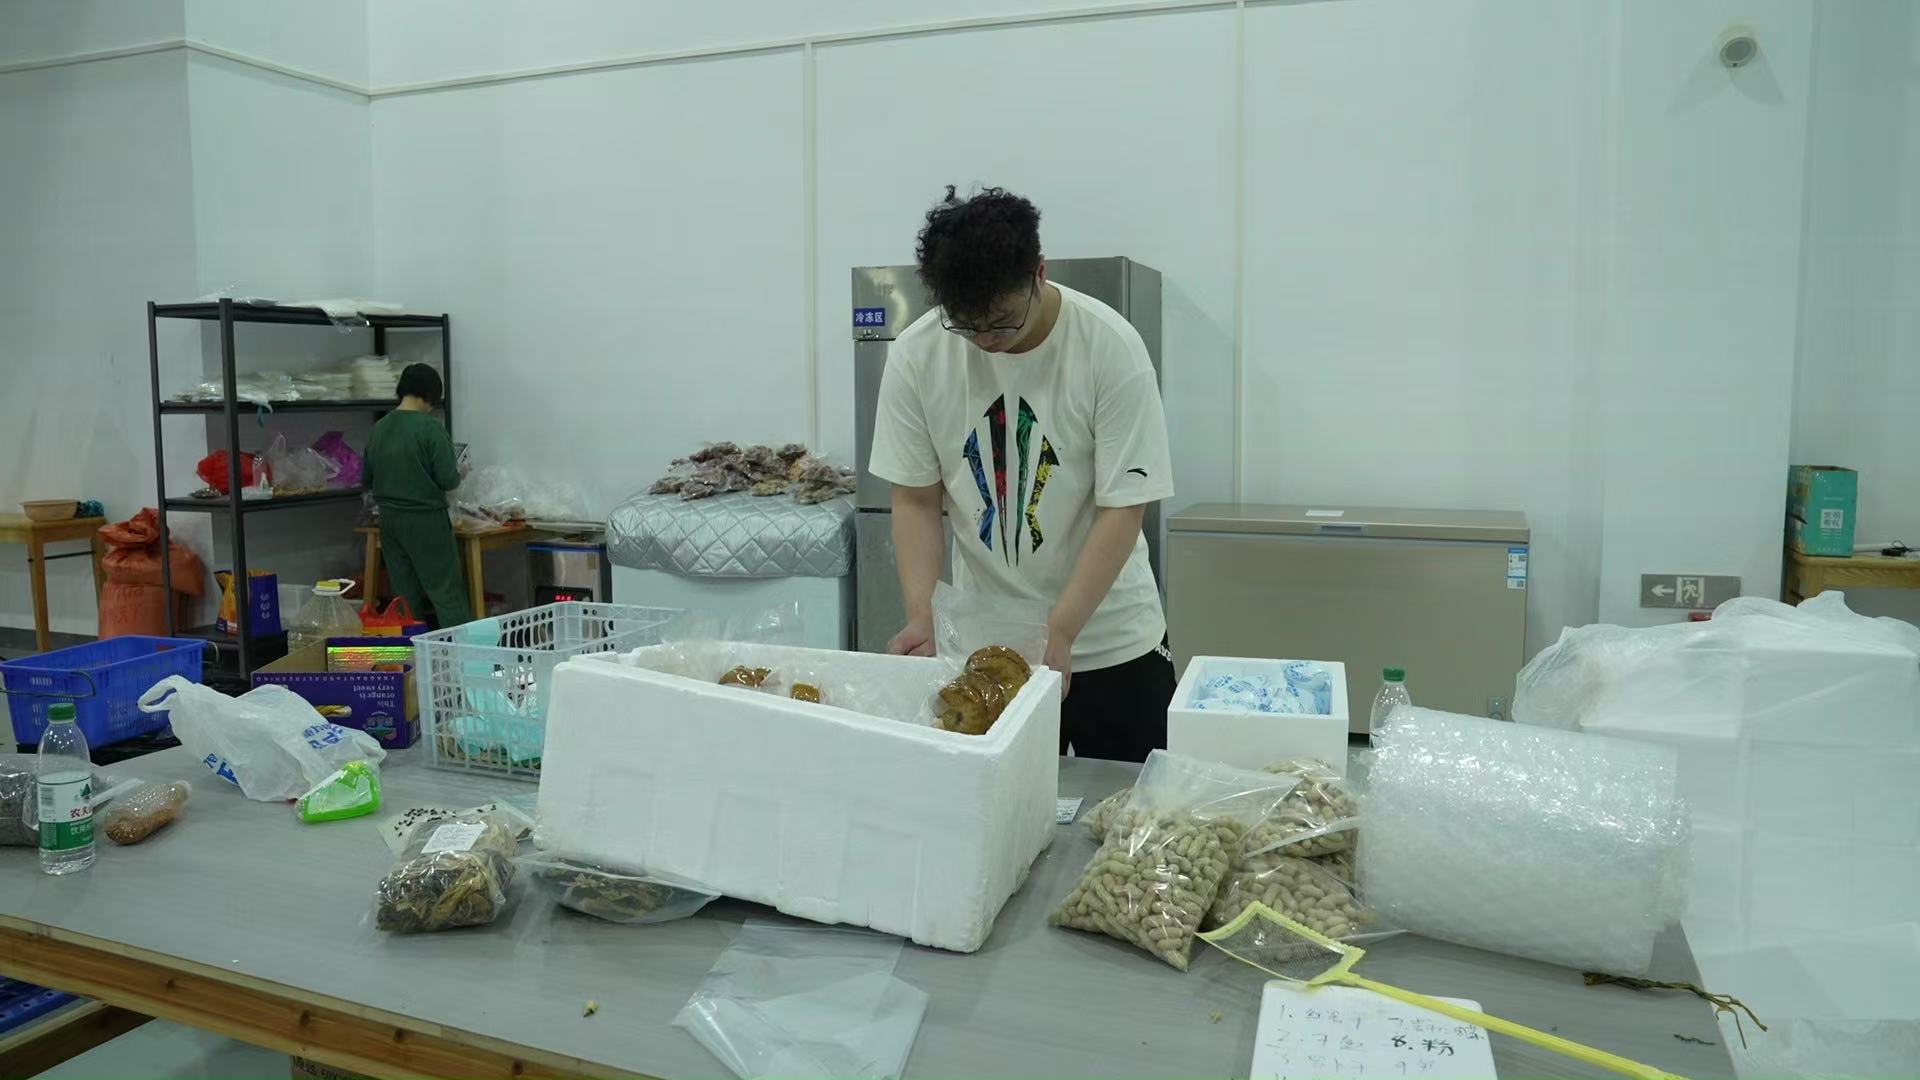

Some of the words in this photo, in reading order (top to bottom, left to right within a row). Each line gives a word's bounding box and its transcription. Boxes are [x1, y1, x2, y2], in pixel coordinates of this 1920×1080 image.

[856, 312, 883, 323] 冷冻区
[353, 684, 375, 692] sweet
[376, 684, 395, 692] very
[360, 692, 366, 700] is
[366, 691, 395, 700] orange
[378, 700, 395, 708] This
